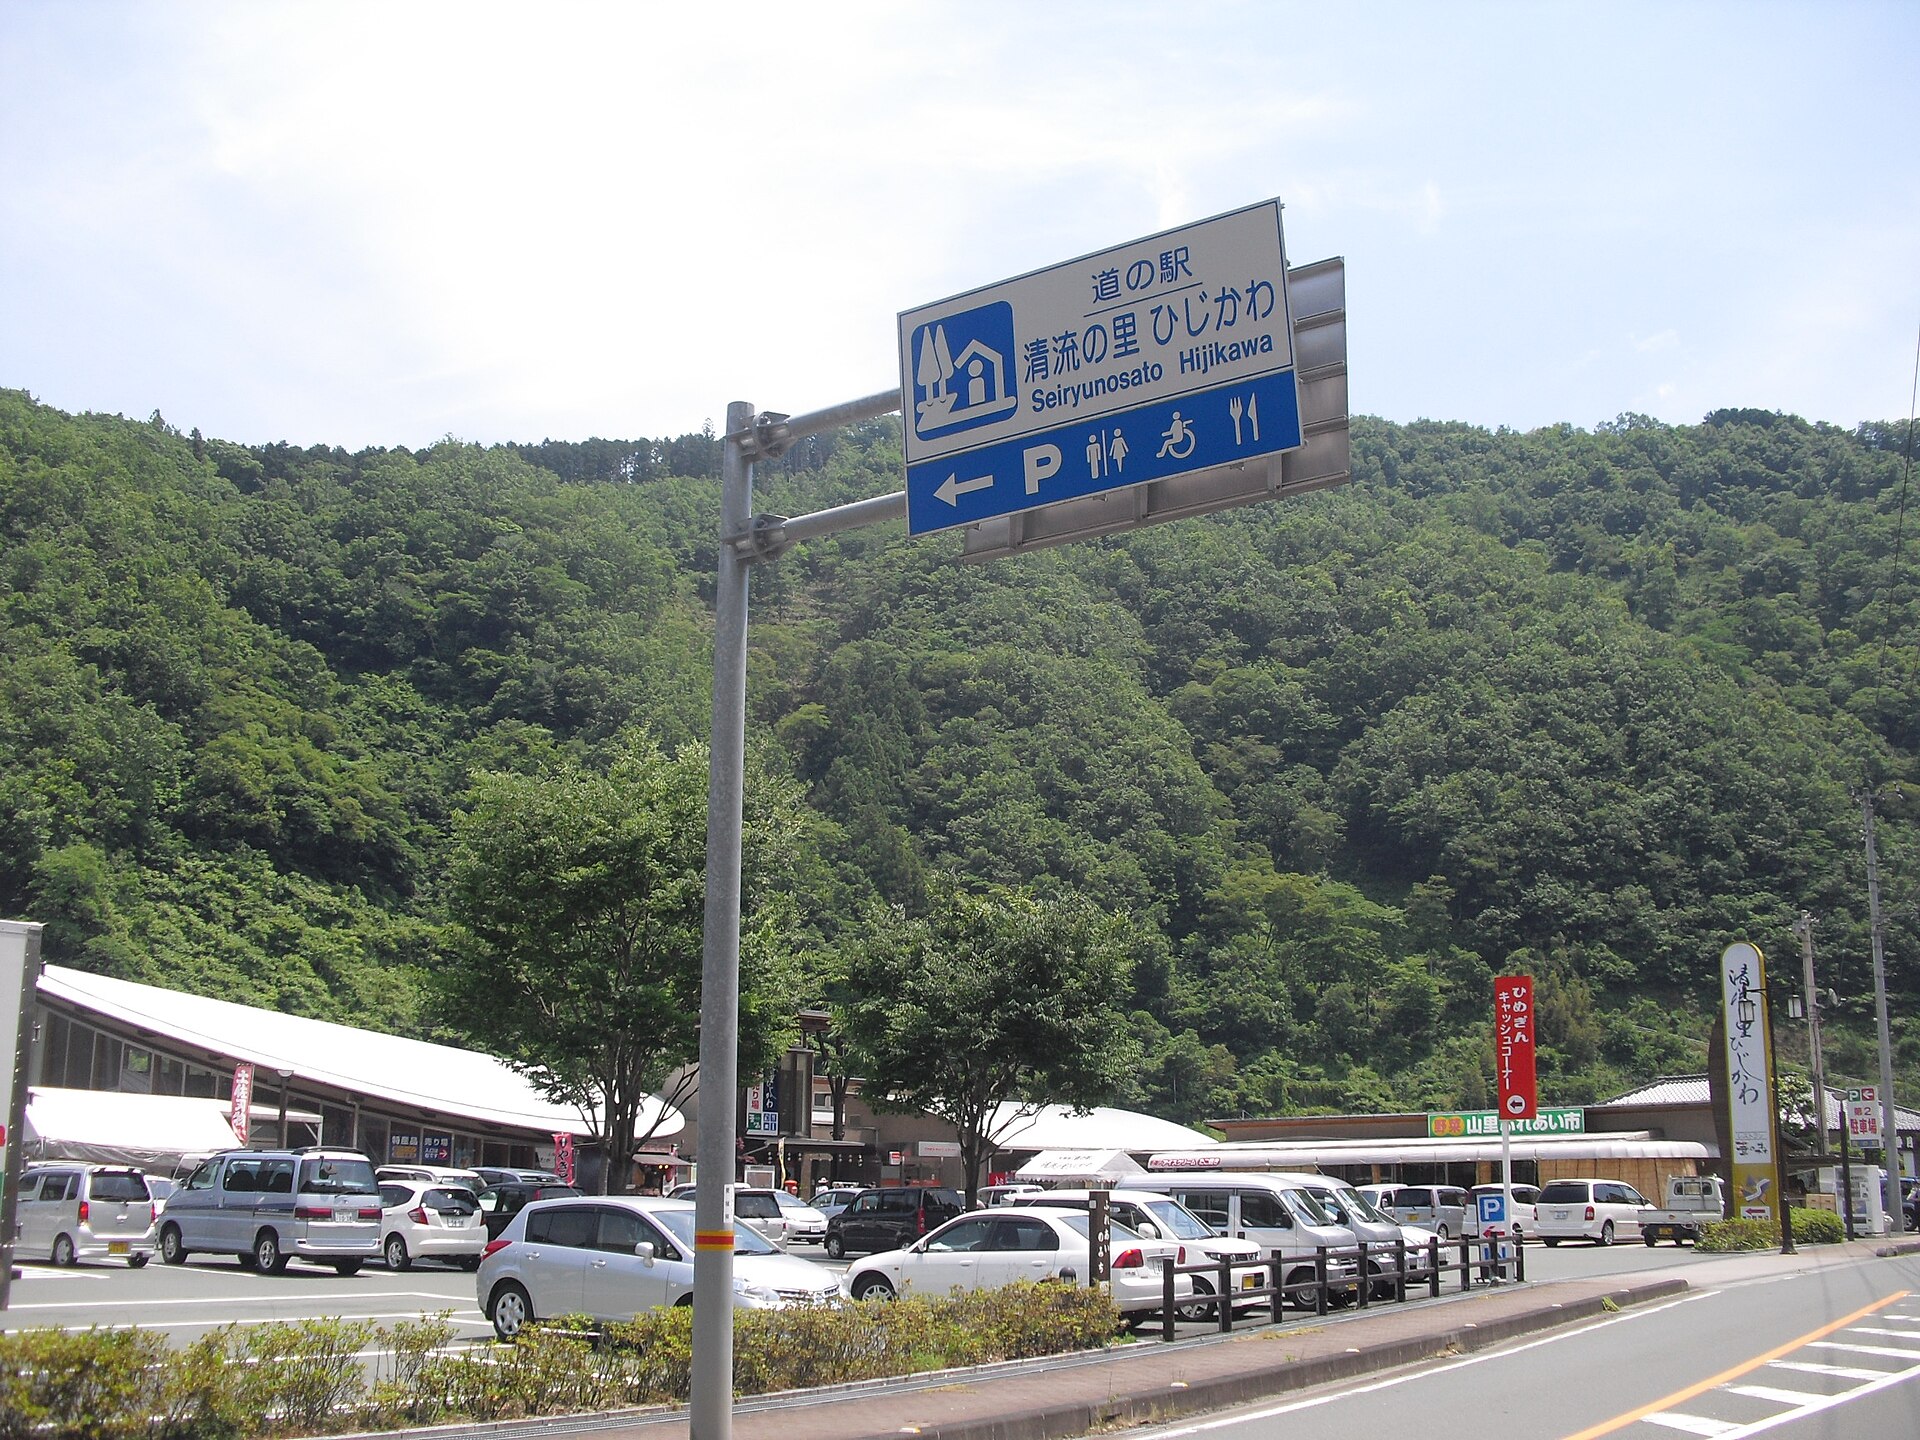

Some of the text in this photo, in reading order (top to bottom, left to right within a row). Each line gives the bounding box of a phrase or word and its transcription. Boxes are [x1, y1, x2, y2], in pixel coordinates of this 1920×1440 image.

[1091, 246, 1193, 304] 道の駅
[1024, 279, 1275, 383] 清流の里 ひじかわ
[1032, 334, 1273, 413] Seiryunosato Hijikawa
[1023, 443, 1063, 495] P
[1499, 991, 1512, 1090] キャッシュコーナー
[1512, 986, 1529, 1043] ひめぎん
[1729, 963, 1763, 1105] 清流里ひじかわ
[1849, 1091, 1859, 1101] P
[425, 1137, 448, 1146] 売り場
[1850, 1118, 1878, 1135] 駐車場
[1483, 1198, 1501, 1220] P
